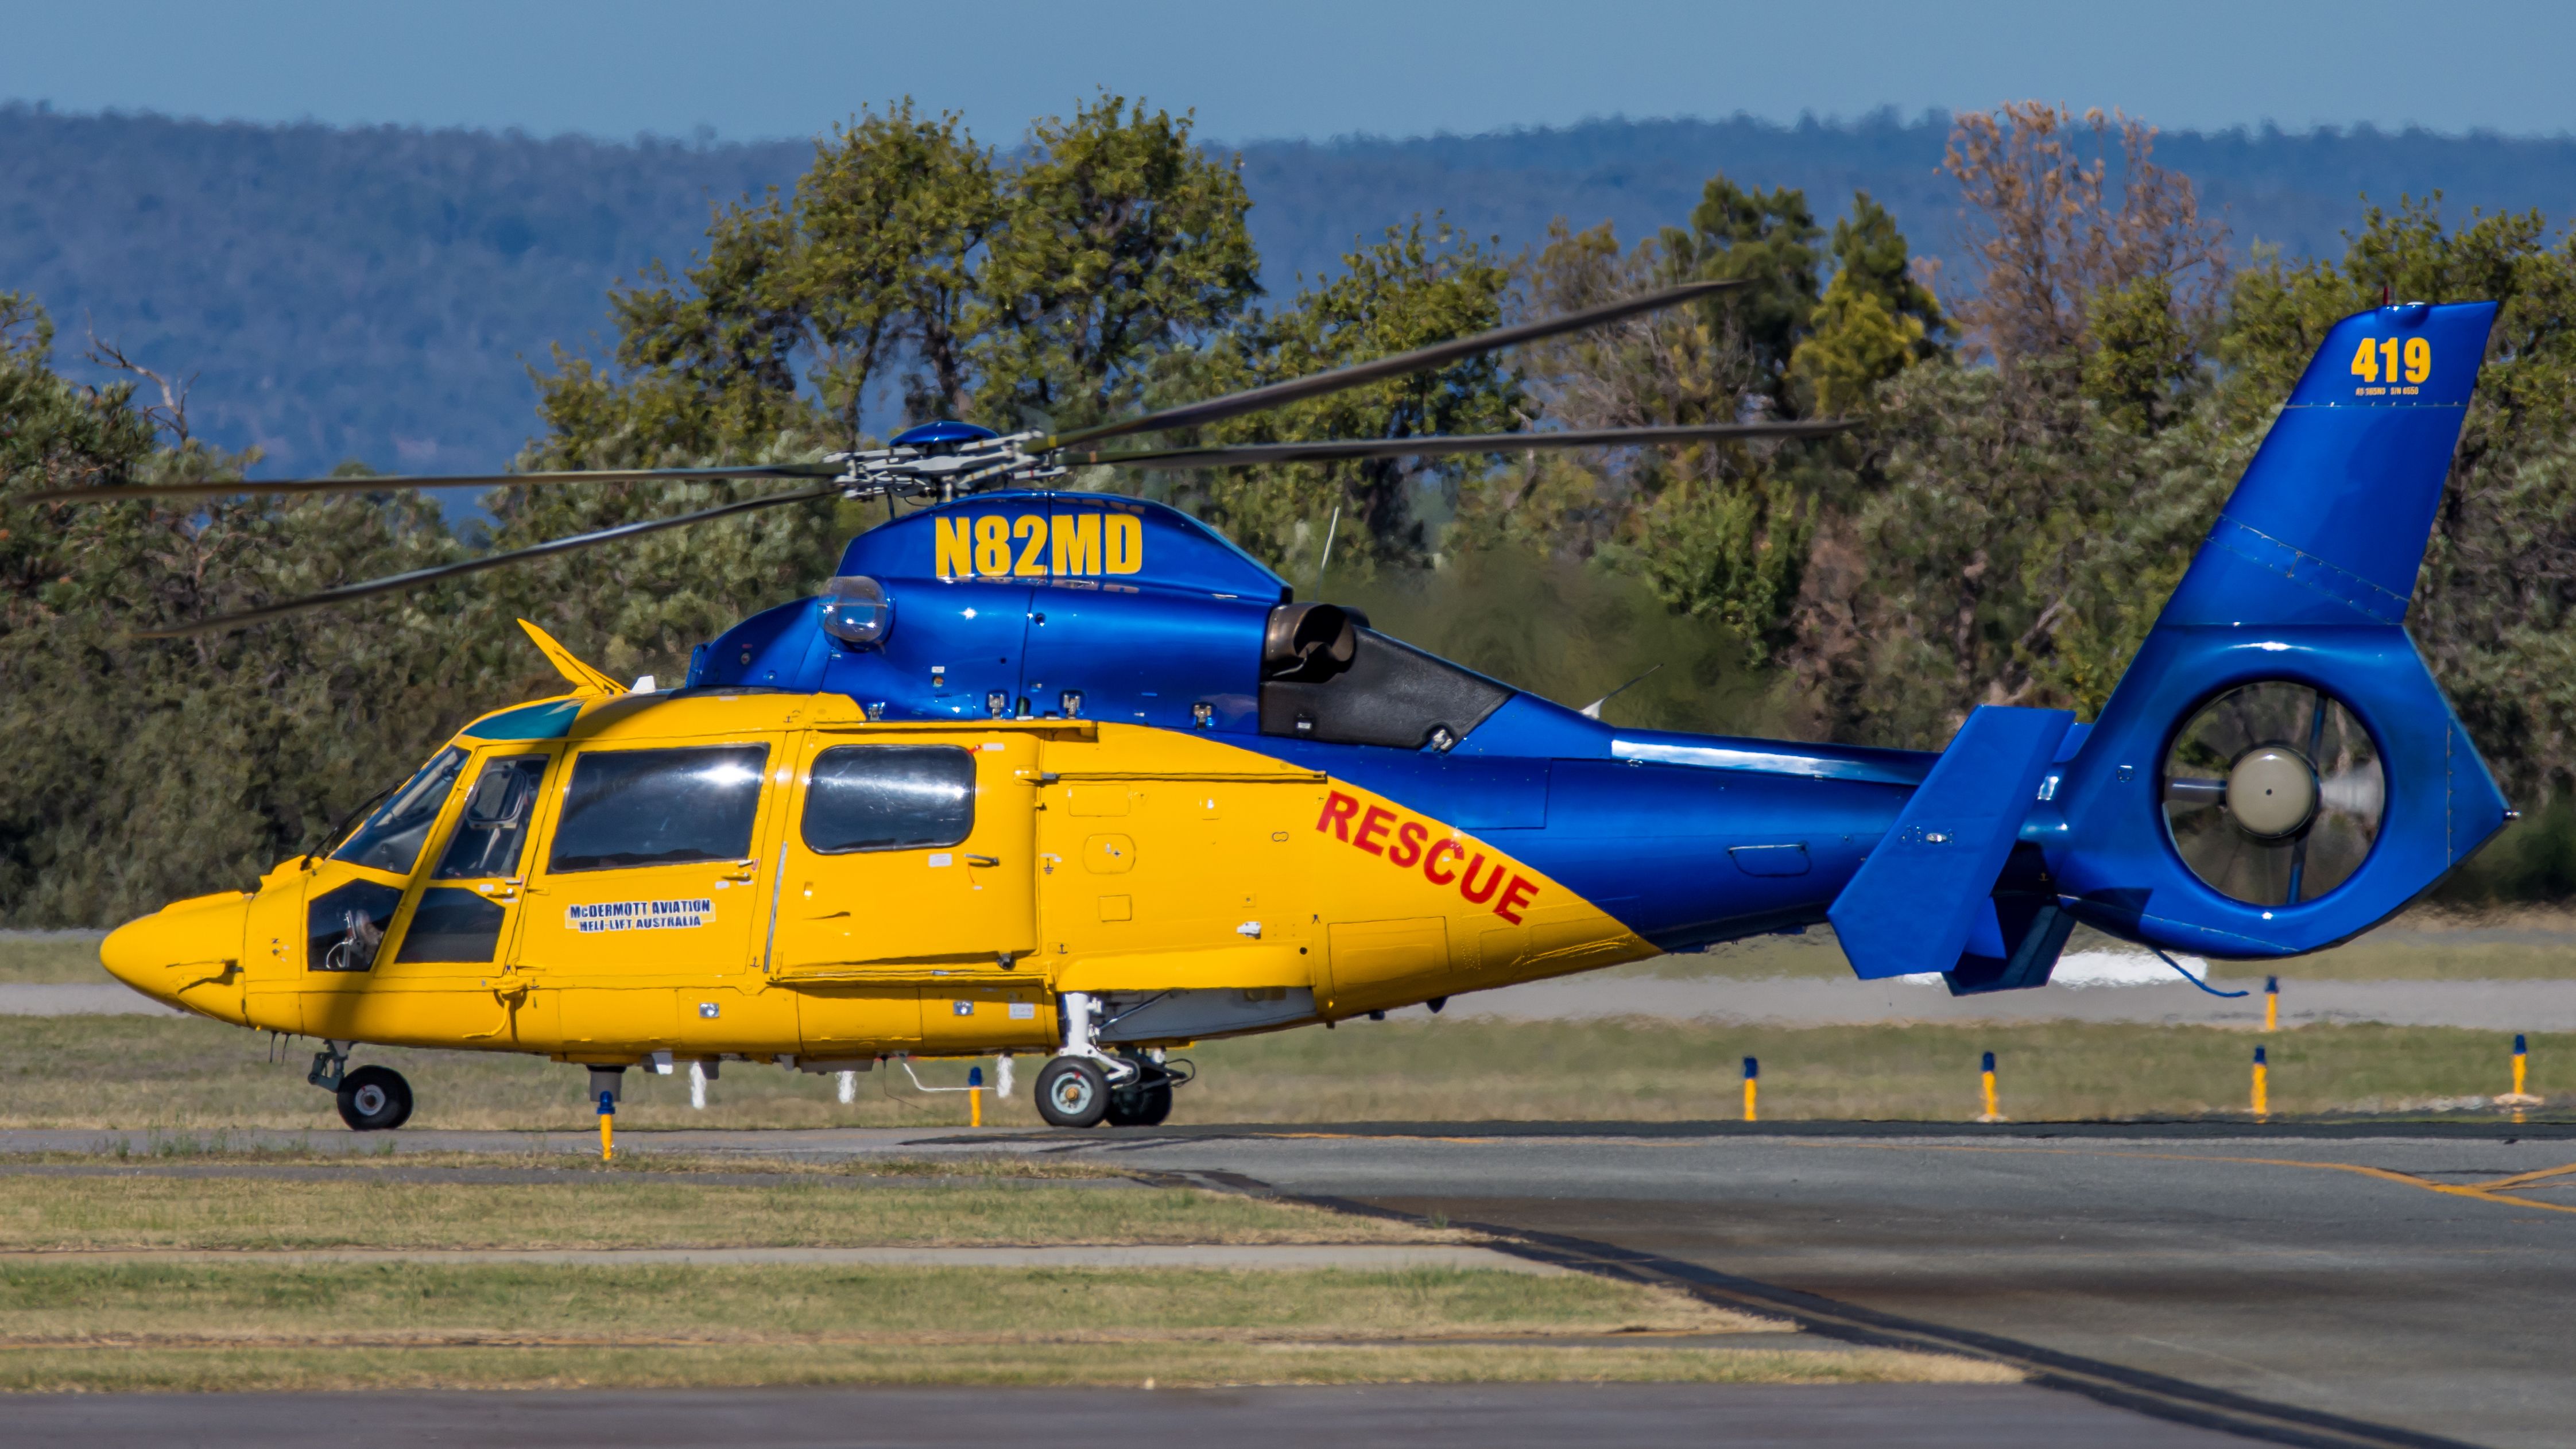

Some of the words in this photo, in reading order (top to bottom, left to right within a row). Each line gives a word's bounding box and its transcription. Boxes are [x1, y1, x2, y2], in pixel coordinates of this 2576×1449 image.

[2351, 337, 2431, 383] 419
[935, 513, 1142, 580] N82MD
[1315, 789, 1540, 926] RESCUE
[570, 902, 648, 918] McDERMOTT
[652, 900, 710, 915] AVIATION
[579, 919, 632, 932] HELI-LIFT
[636, 916, 701, 928] AUSTRALIA
